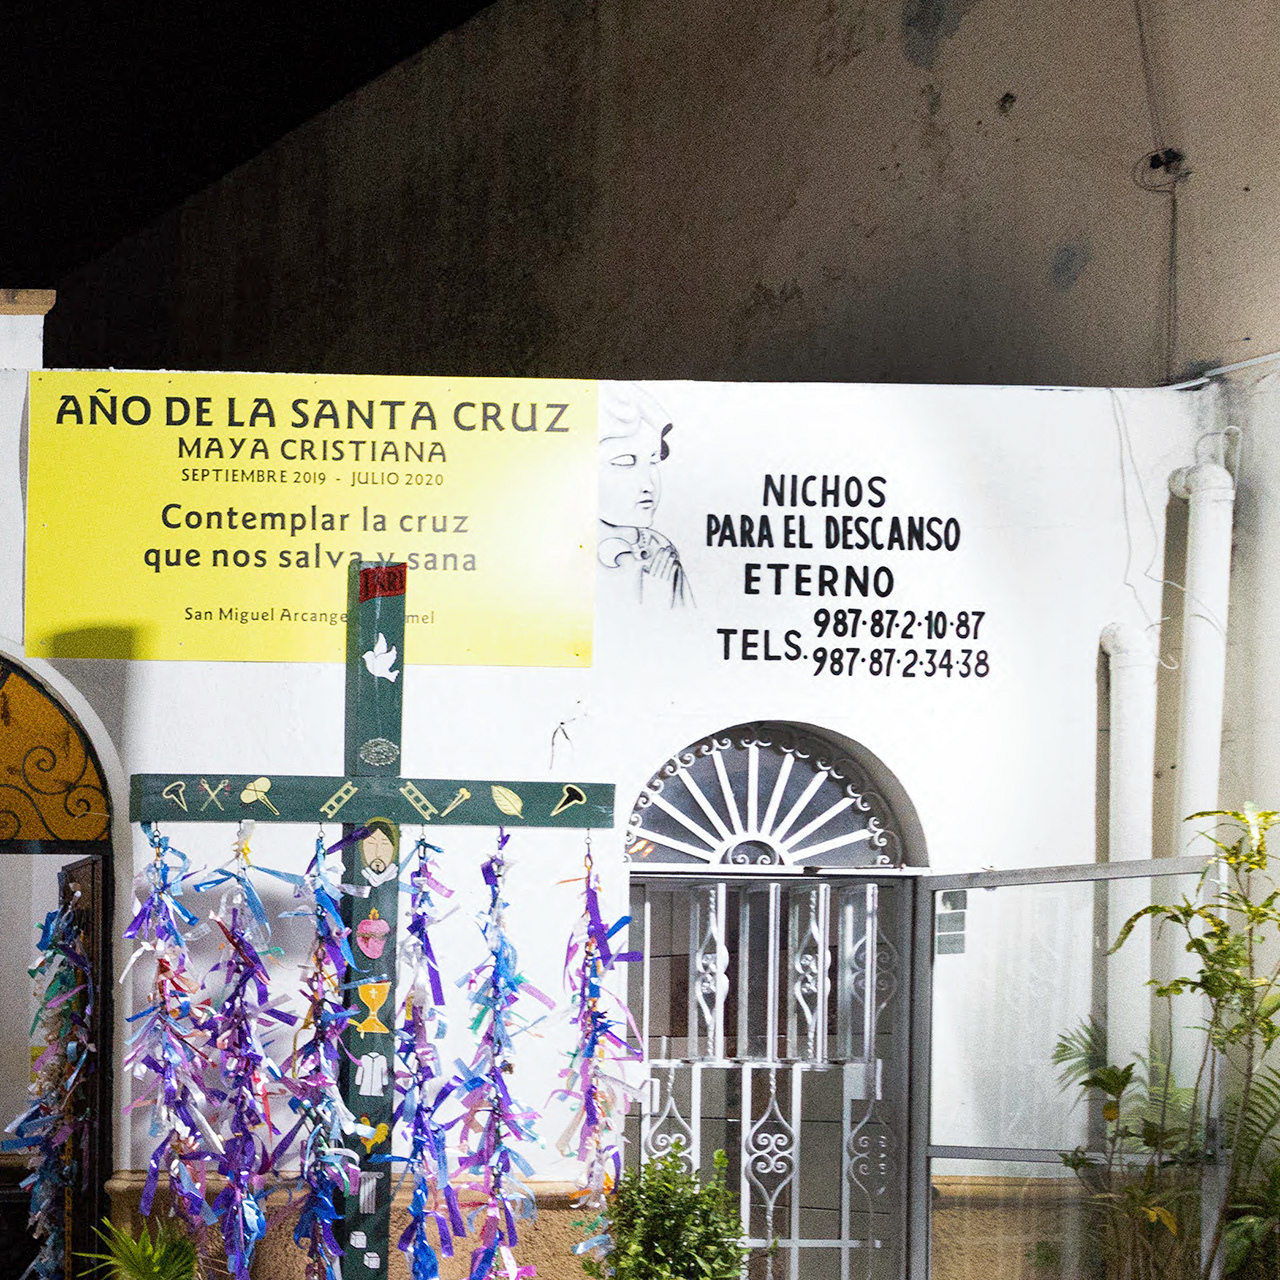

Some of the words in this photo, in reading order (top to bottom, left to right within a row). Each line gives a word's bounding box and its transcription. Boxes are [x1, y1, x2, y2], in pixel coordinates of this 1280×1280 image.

[56, 388, 151, 425] AÑO
[166, 397, 212, 426] DE
[228, 398, 275, 427] LA
[291, 399, 436, 430] SANTA
[454, 402, 568, 432] CRUZ
[179, 437, 269, 459] MAYA
[281, 439, 446, 462] CRISTIANA
[182, 468, 286, 483] SEPTIEMBRE
[294, 471, 326, 484] 2019
[351, 472, 399, 487] JULIO
[405, 473, 443, 486] 2020
[763, 474, 886, 508] NICHOS
[162, 504, 349, 536] Contemplar
[363, 506, 386, 531] la
[400, 515, 467, 532] cruz
[707, 514, 774, 548] PARA
[784, 515, 813, 548] EL
[825, 516, 960, 551] DESCANSO
[144, 549, 200, 573] que
[213, 549, 266, 567] nos
[407, 549, 477, 572] sana
[745, 563, 894, 597] ETERNO
[185, 607, 212, 620] San
[219, 608, 274, 624] Miguel
[280, 607, 348, 626] Arcange
[717, 629, 807, 661] TELS.
